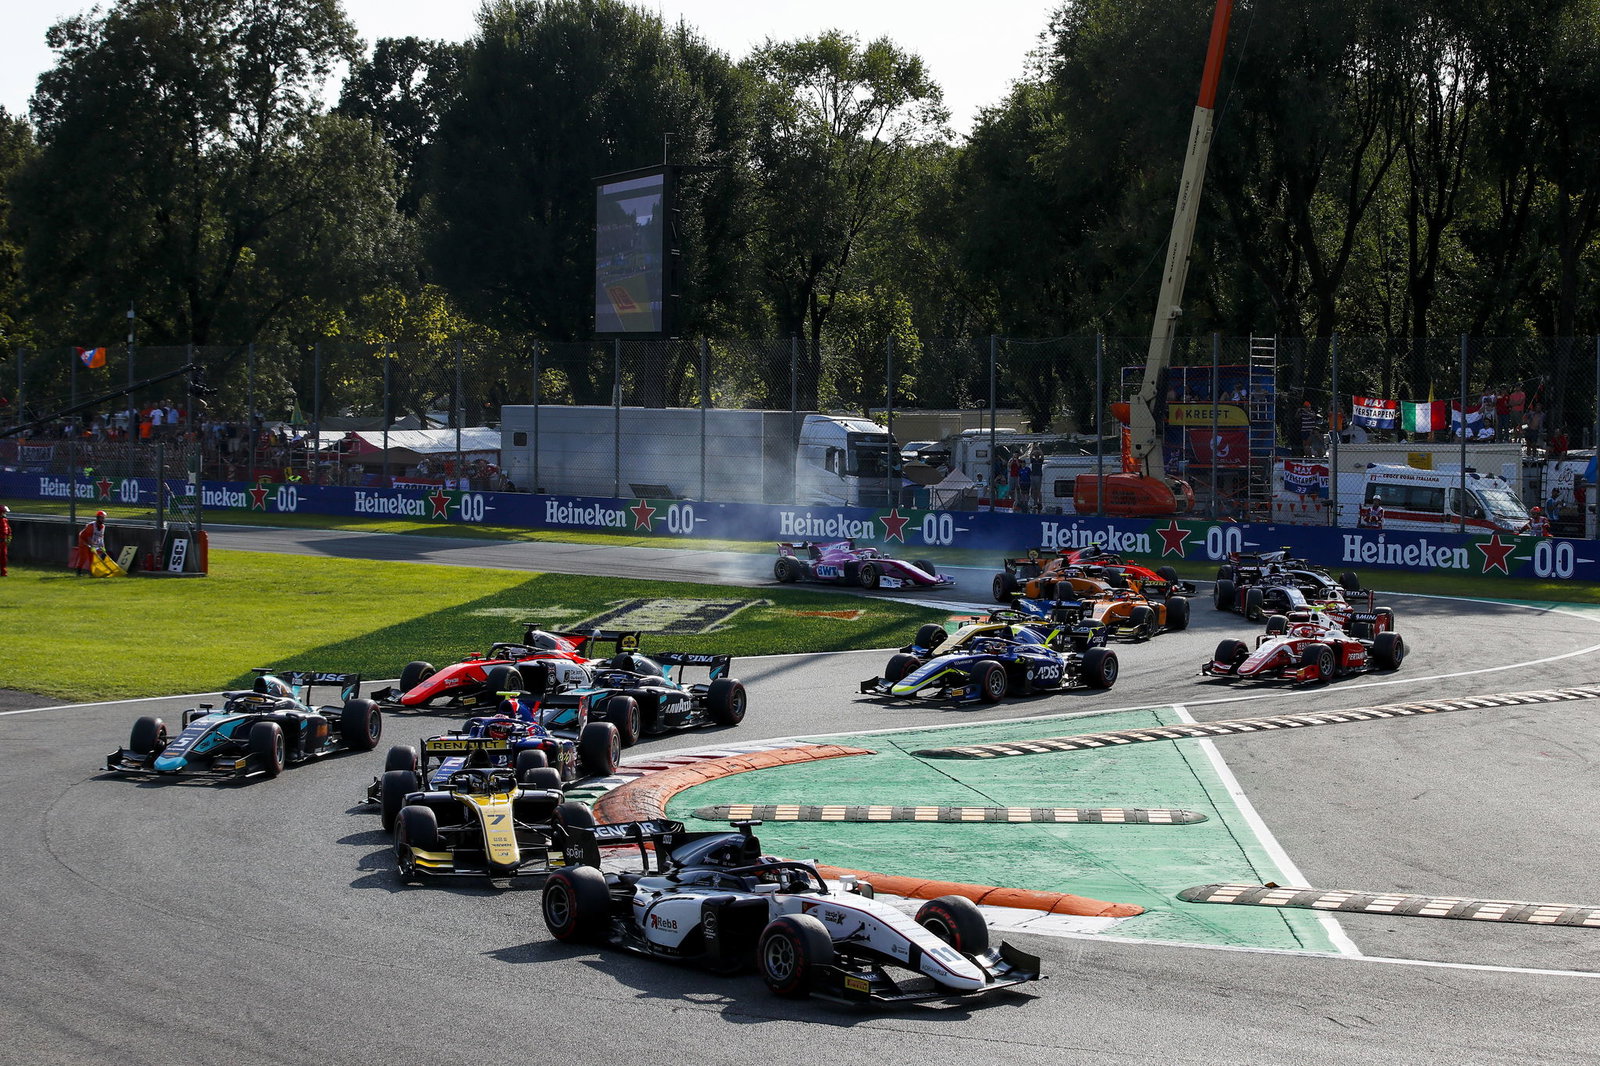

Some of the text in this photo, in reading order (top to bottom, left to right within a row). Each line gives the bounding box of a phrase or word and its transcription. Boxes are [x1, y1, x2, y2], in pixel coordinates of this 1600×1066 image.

[1364, 398, 1385, 407] MAX
[1186, 409, 1229, 419] KREEFT
[1354, 406, 1394, 418] VERSTAPPEN
[1366, 419, 1377, 427] 33
[1294, 465, 1312, 475] MAX
[40, 477, 94, 498] Heineken
[185, 481, 297, 512] Hineken 0.0
[354, 491, 484, 521] Heineken 0.0
[545, 501, 694, 534] Heineken 0.0
[780, 511, 953, 545] Heineken 0.0
[1041, 521, 1242, 560] Heineken 0.0
[1342, 534, 1574, 579] Heineken 0.0
[433, 741, 499, 750] RENAULT
[487, 814, 506, 825] 7
[584, 822, 657, 838] SENCR
[930, 946, 962, 963] 11
